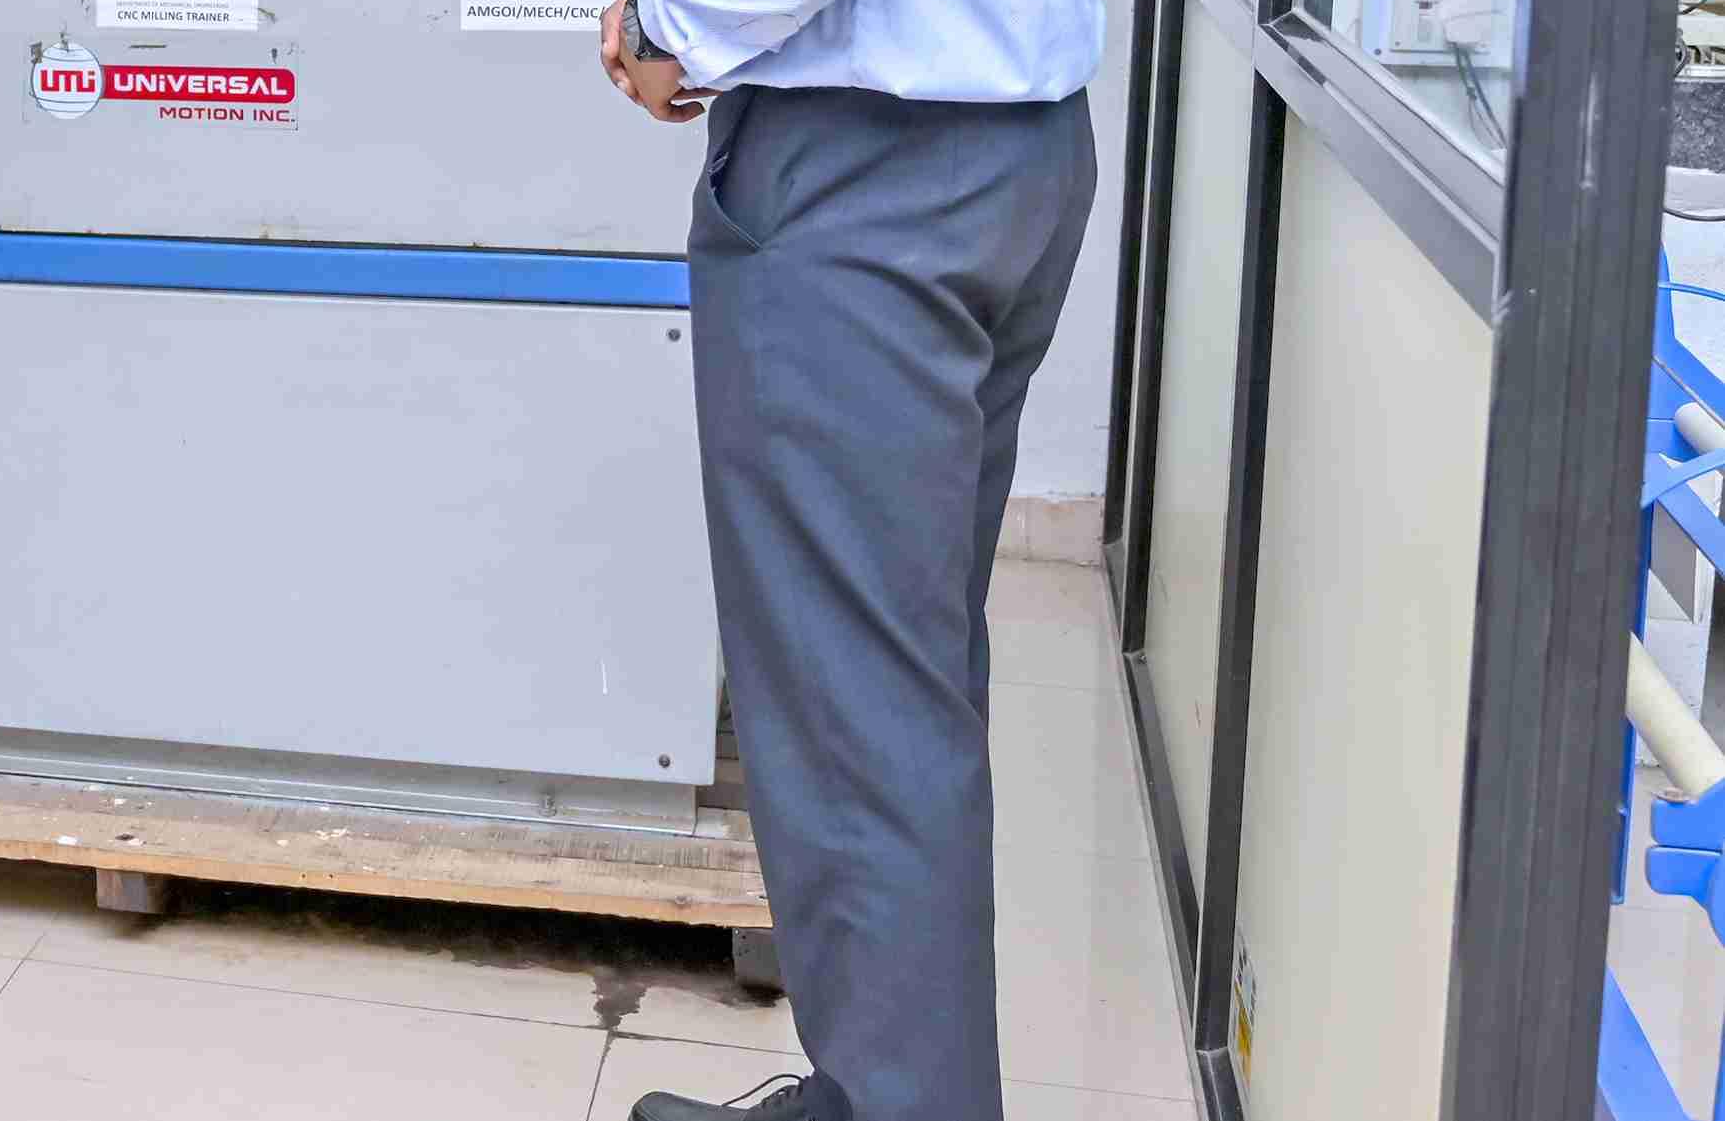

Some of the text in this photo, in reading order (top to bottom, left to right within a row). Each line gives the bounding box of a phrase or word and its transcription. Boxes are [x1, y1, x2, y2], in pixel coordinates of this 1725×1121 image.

[117, 10, 229, 22] CNC MILLING TRAINER
[159, 107, 296, 122] MOTION INC.
